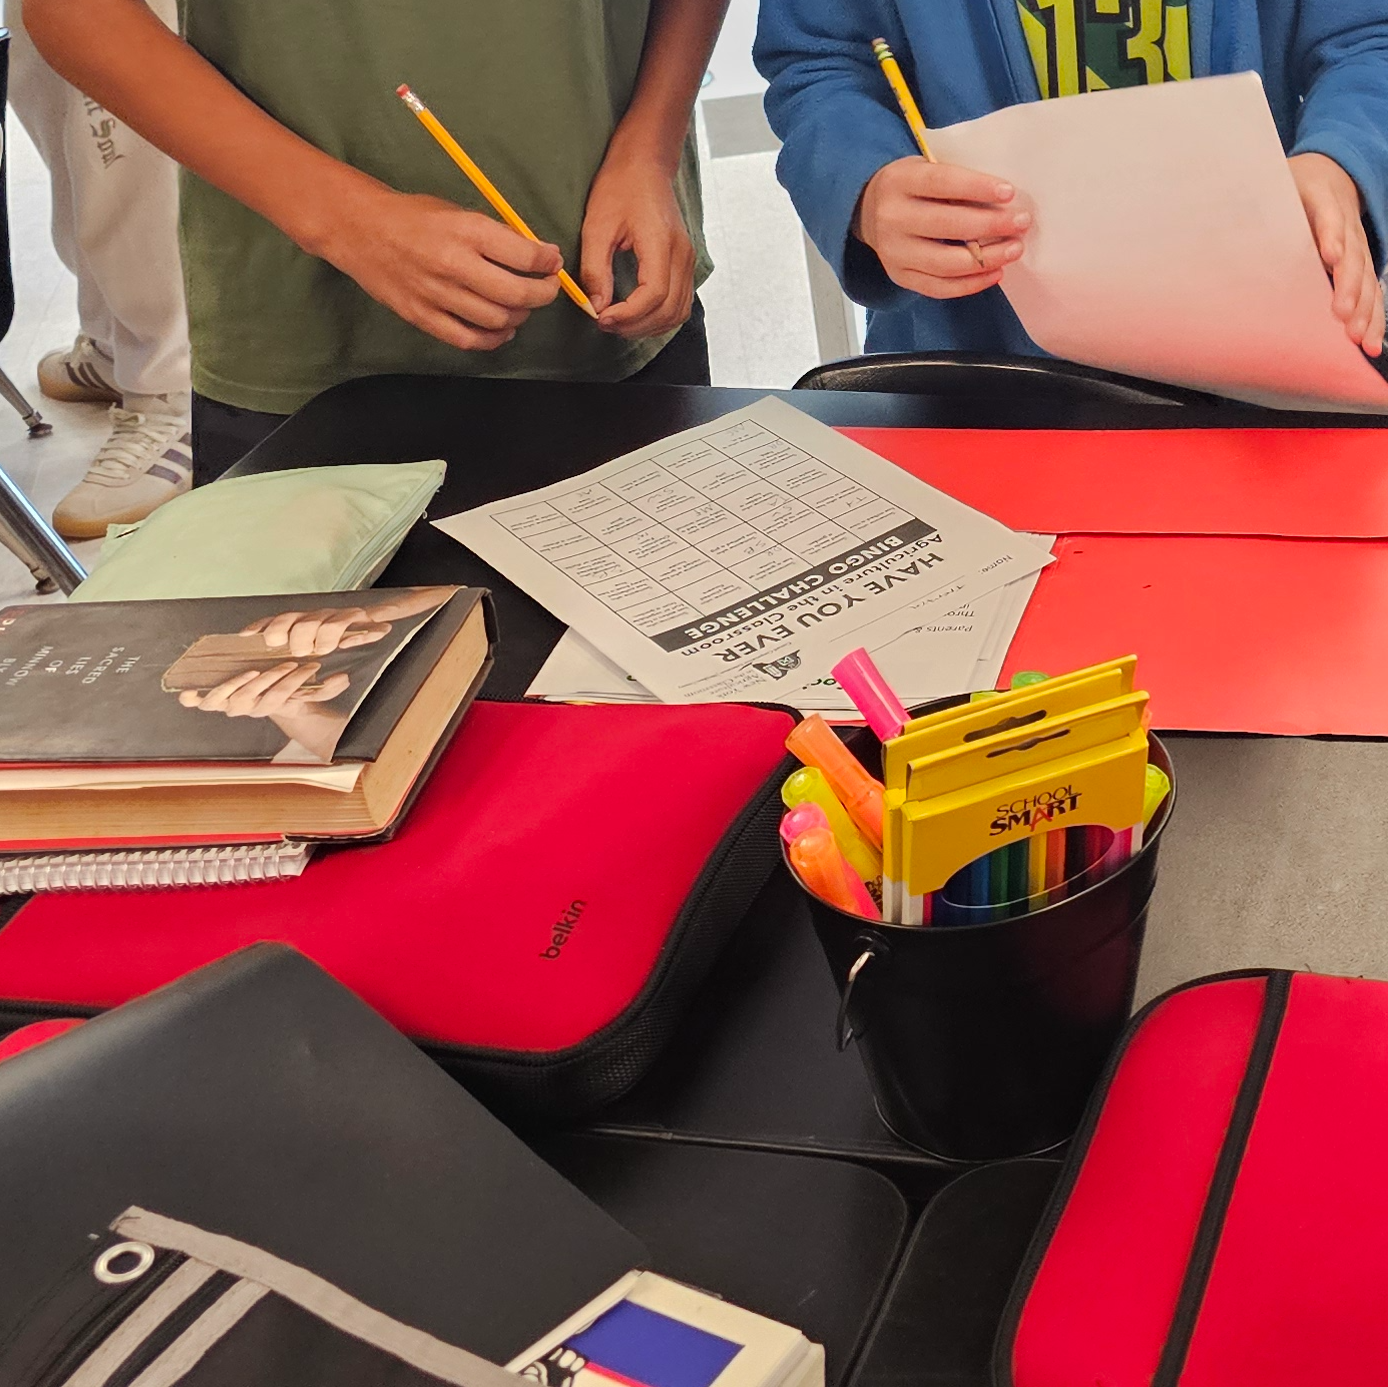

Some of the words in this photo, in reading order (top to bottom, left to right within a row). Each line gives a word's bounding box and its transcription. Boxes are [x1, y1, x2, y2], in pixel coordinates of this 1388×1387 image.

[828, 535, 903, 573] BINGO
[842, 533, 942, 583] Agriculture
[821, 584, 843, 594] in
[863, 552, 944, 594] HAVE
[684, 574, 823, 638] CHALLENGE
[786, 595, 819, 610] the
[796, 593, 865, 627] YOU
[680, 612, 784, 656] Classroom
[712, 624, 794, 661] EVER
[926, 625, 974, 633] Parents
[5, 645, 54, 686] MINNOW
[45, 659, 63, 673] OF
[65, 656, 92, 675] LIES
[81, 646, 126, 684] SACRED
[115, 655, 141, 674] THE
[989, 793, 1083, 836] SMART
[996, 784, 1074, 817] SCHOOL
[539, 899, 588, 960] belkin
